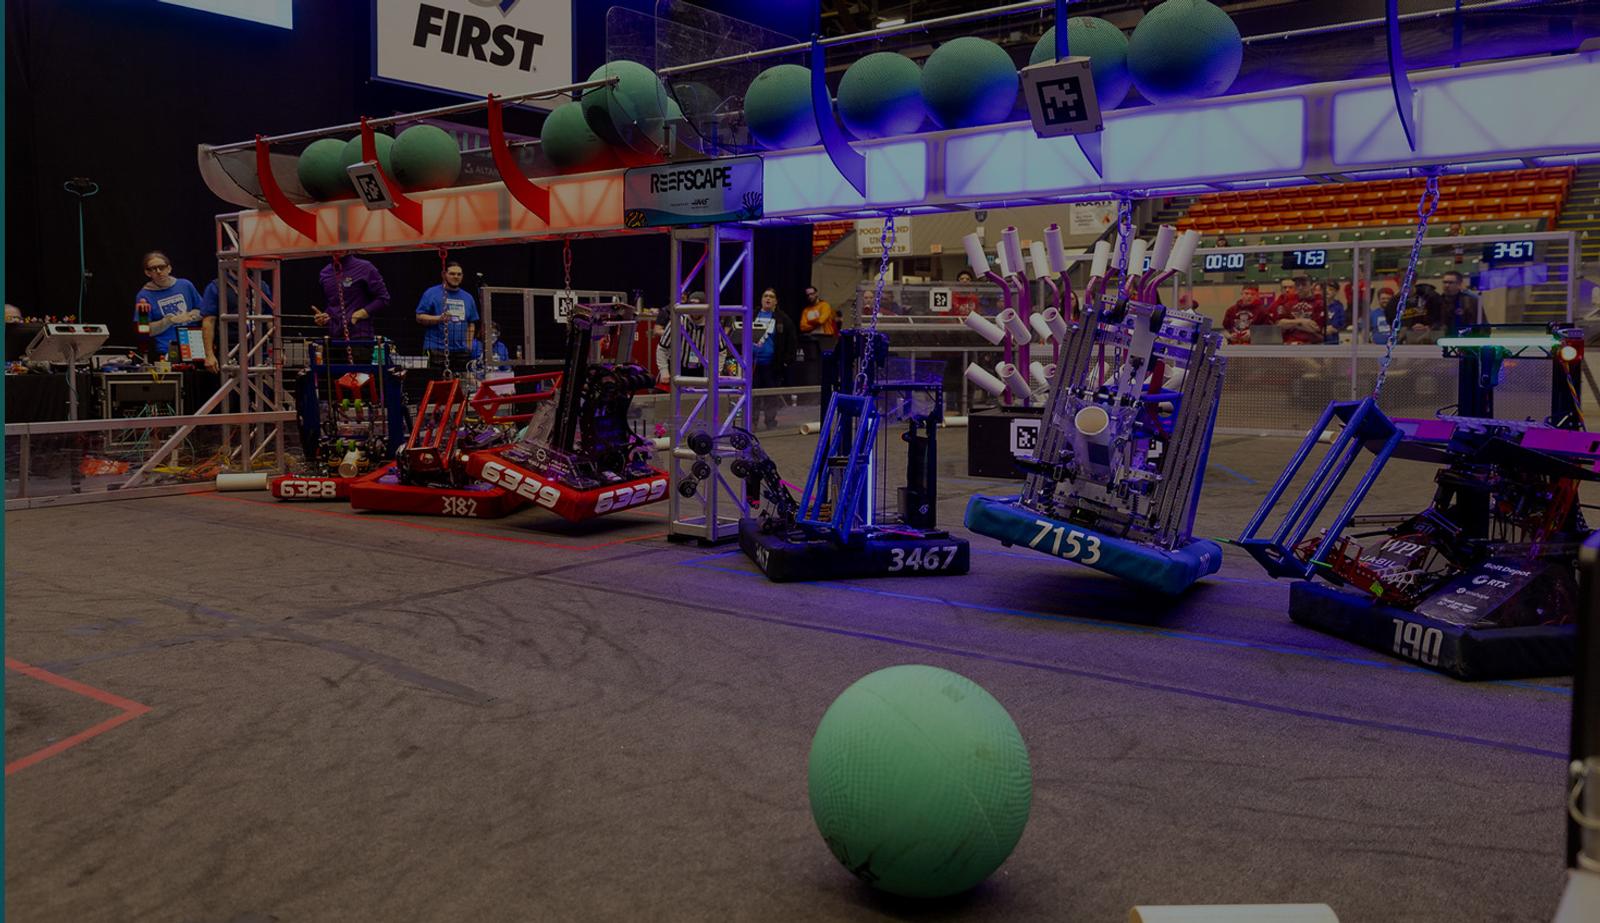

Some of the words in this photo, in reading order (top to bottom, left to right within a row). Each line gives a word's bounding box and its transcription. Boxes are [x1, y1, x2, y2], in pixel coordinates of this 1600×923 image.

[413, 3, 544, 72] FIRST
[650, 166, 732, 193] REEFSCAPE
[1205, 254, 1244, 269] 00:00
[1493, 241, 1534, 259] 3467
[280, 480, 336, 499] 6328
[481, 461, 561, 509] 6329
[593, 478, 667, 514] 6329
[442, 496, 478, 517] 3182
[1028, 519, 1101, 565] 7153
[1380, 539, 1427, 557] WPI
[888, 546, 958, 571] 3467
[1487, 579, 1511, 589] RTX
[1392, 618, 1444, 667] 190
